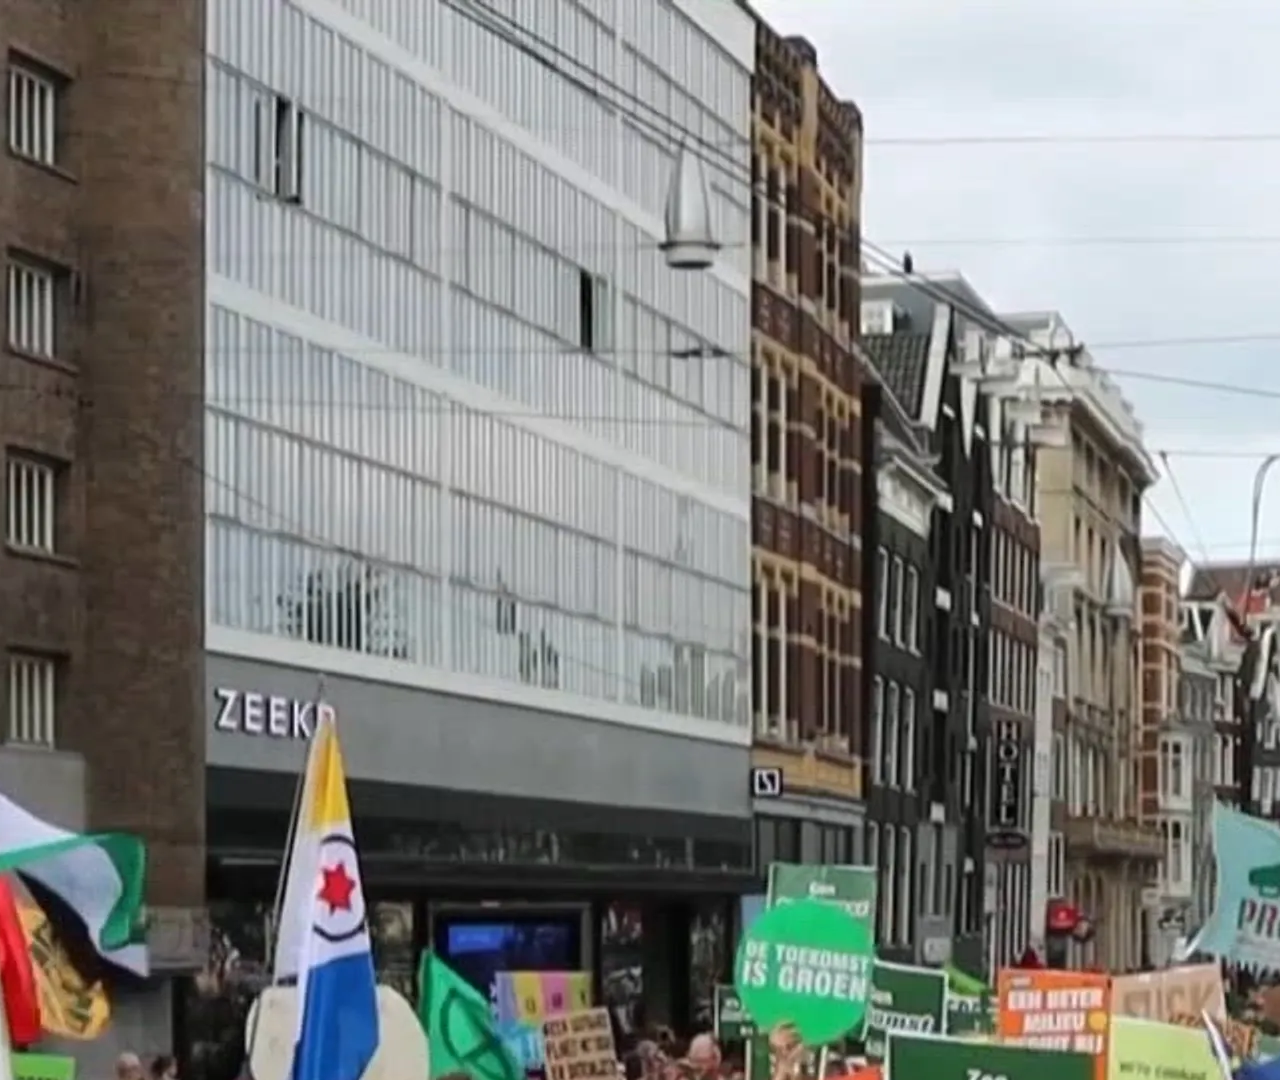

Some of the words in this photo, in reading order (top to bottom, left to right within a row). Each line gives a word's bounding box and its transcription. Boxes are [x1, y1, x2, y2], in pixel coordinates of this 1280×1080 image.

[1000, 720, 1018, 824] HOTEL
[746, 941, 769, 957] DE
[775, 945, 869, 974] TOEKOMST
[742, 960, 769, 986] IS
[778, 966, 869, 1002] GROEN
